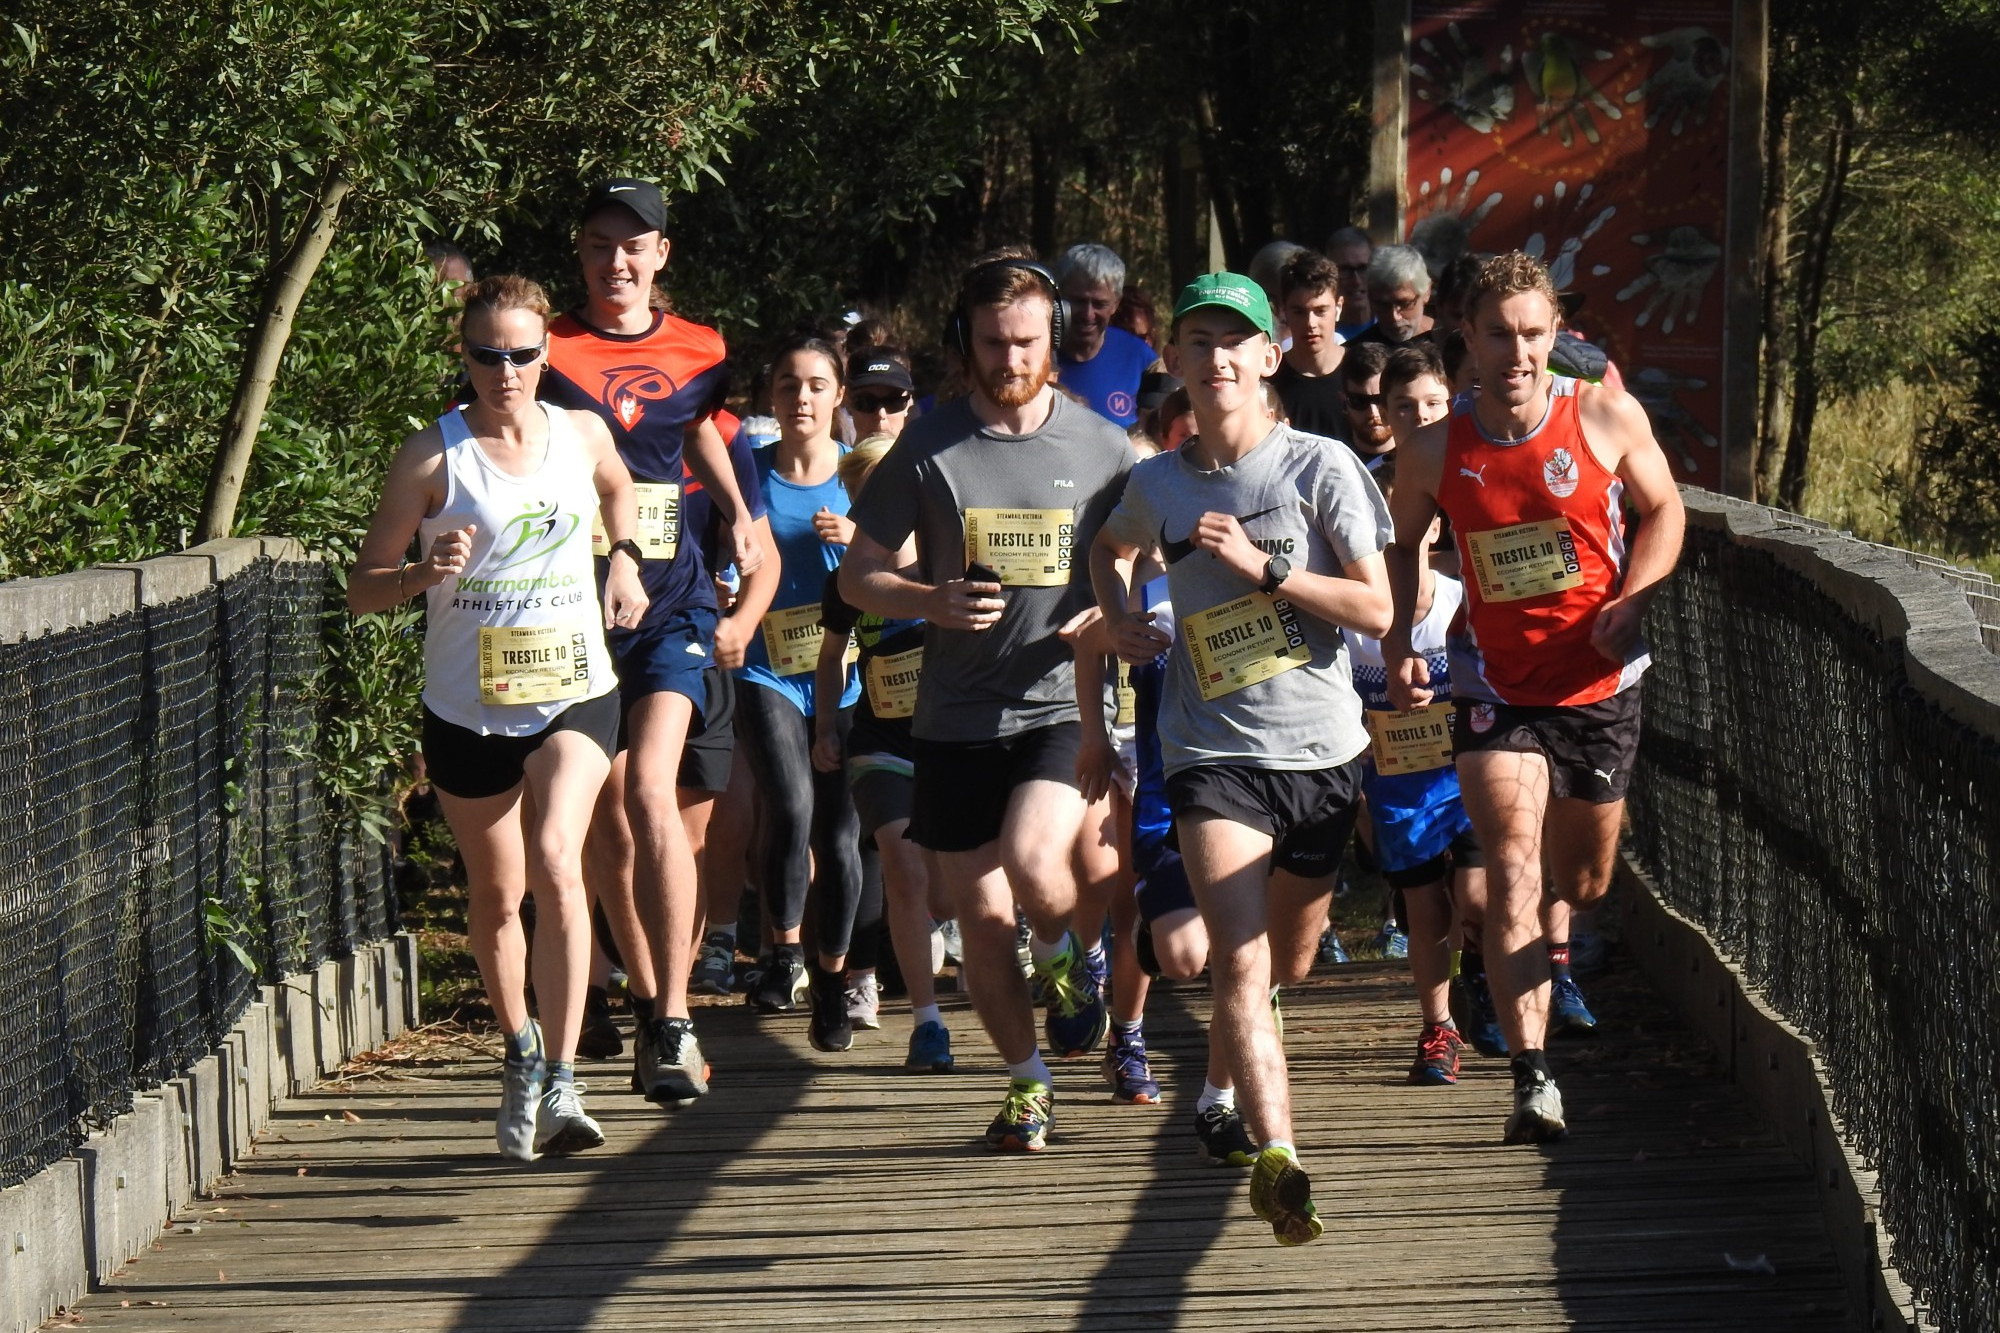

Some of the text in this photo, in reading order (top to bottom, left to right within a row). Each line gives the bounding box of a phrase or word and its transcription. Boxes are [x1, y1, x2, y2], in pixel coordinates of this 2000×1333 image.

[1053, 480, 1074, 488] FILA
[648, 506, 658, 520] 10
[664, 499, 677, 543] 0217
[988, 532, 1051, 547] TRESTLE 10
[1059, 526, 1072, 570] 0262
[1250, 538, 1294, 556] NING
[1490, 541, 1554, 567] TRESTLE 10
[1558, 532, 1578, 573] 0267
[1496, 566, 1528, 576] ECONOMY
[1528, 560, 1554, 570] RETURN
[452, 592, 582, 611] ATHLETICS CLUB
[1230, 599, 1252, 612] VICTORIA
[1276, 599, 1303, 647] 0218
[782, 624, 822, 642] TRESTLE
[1205, 622, 1256, 652] TRESTLE
[1256, 616, 1273, 634] 10
[502, 646, 566, 664] TRESTLE 10
[572, 634, 588, 681] 0194
[1214, 648, 1246, 662] ECONOMY
[1247, 636, 1275, 650] RETURN
[483, 652, 493, 686] FEBRUARY
[880, 668, 920, 687] TRESTLE
[1385, 726, 1428, 742] TRESTLE
[1430, 724, 1442, 736] 10
